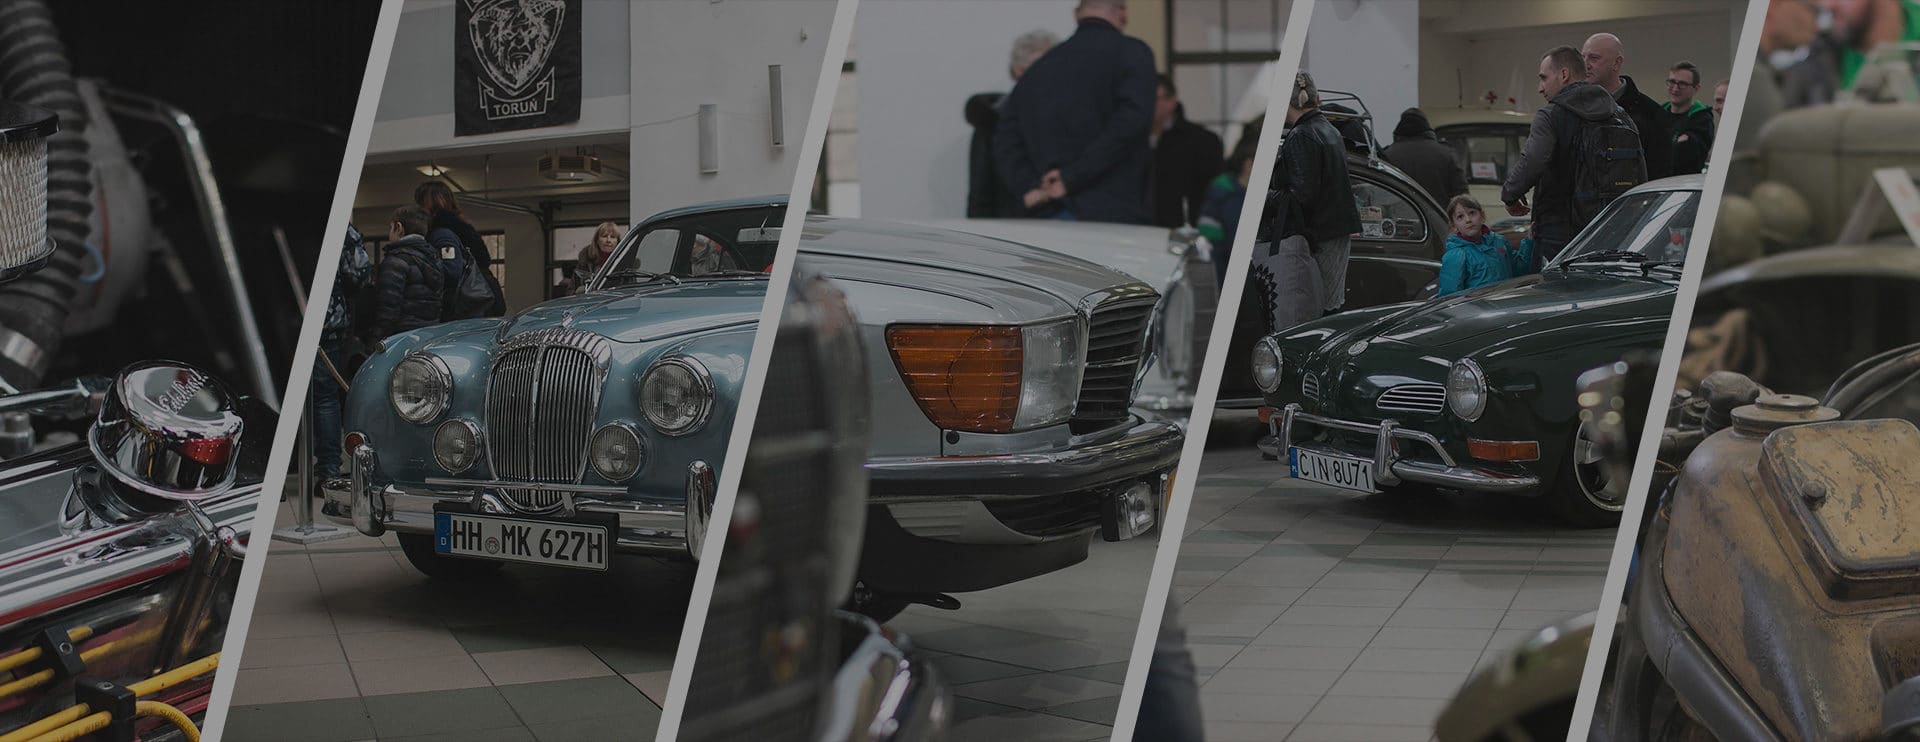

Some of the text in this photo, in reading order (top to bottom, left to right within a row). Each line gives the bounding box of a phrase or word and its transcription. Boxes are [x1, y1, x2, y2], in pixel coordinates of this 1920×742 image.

[493, 98, 538, 116] TORUŃ
[1299, 453, 1370, 489] CIN 8U71
[452, 520, 603, 564] HH MK 627H
